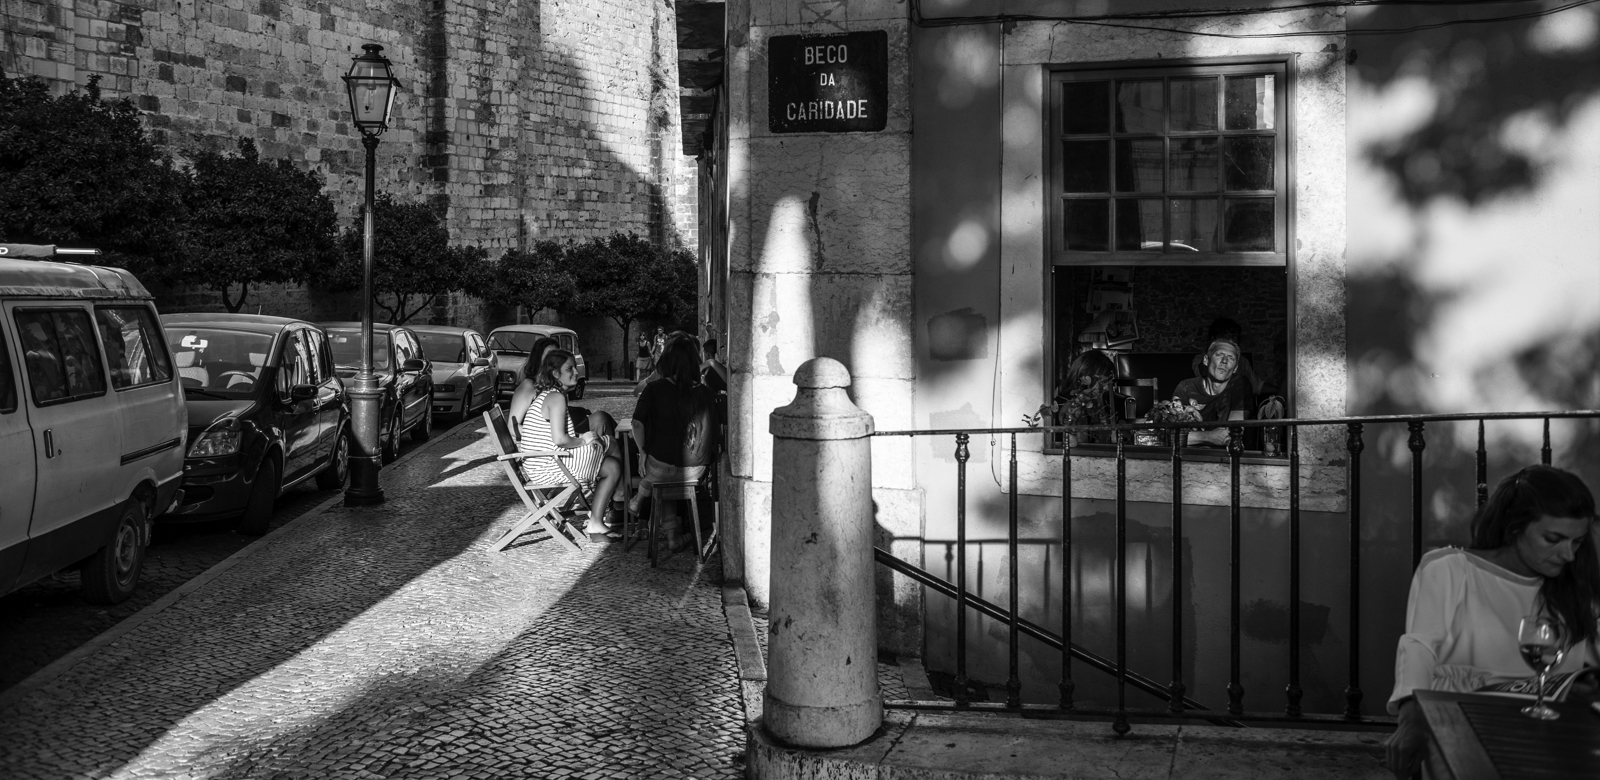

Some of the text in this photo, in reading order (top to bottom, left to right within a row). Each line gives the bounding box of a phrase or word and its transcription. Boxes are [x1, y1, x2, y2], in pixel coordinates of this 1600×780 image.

[805, 44, 848, 65] BECO
[820, 73, 835, 86] DA
[787, 99, 868, 120] CARIDADE
